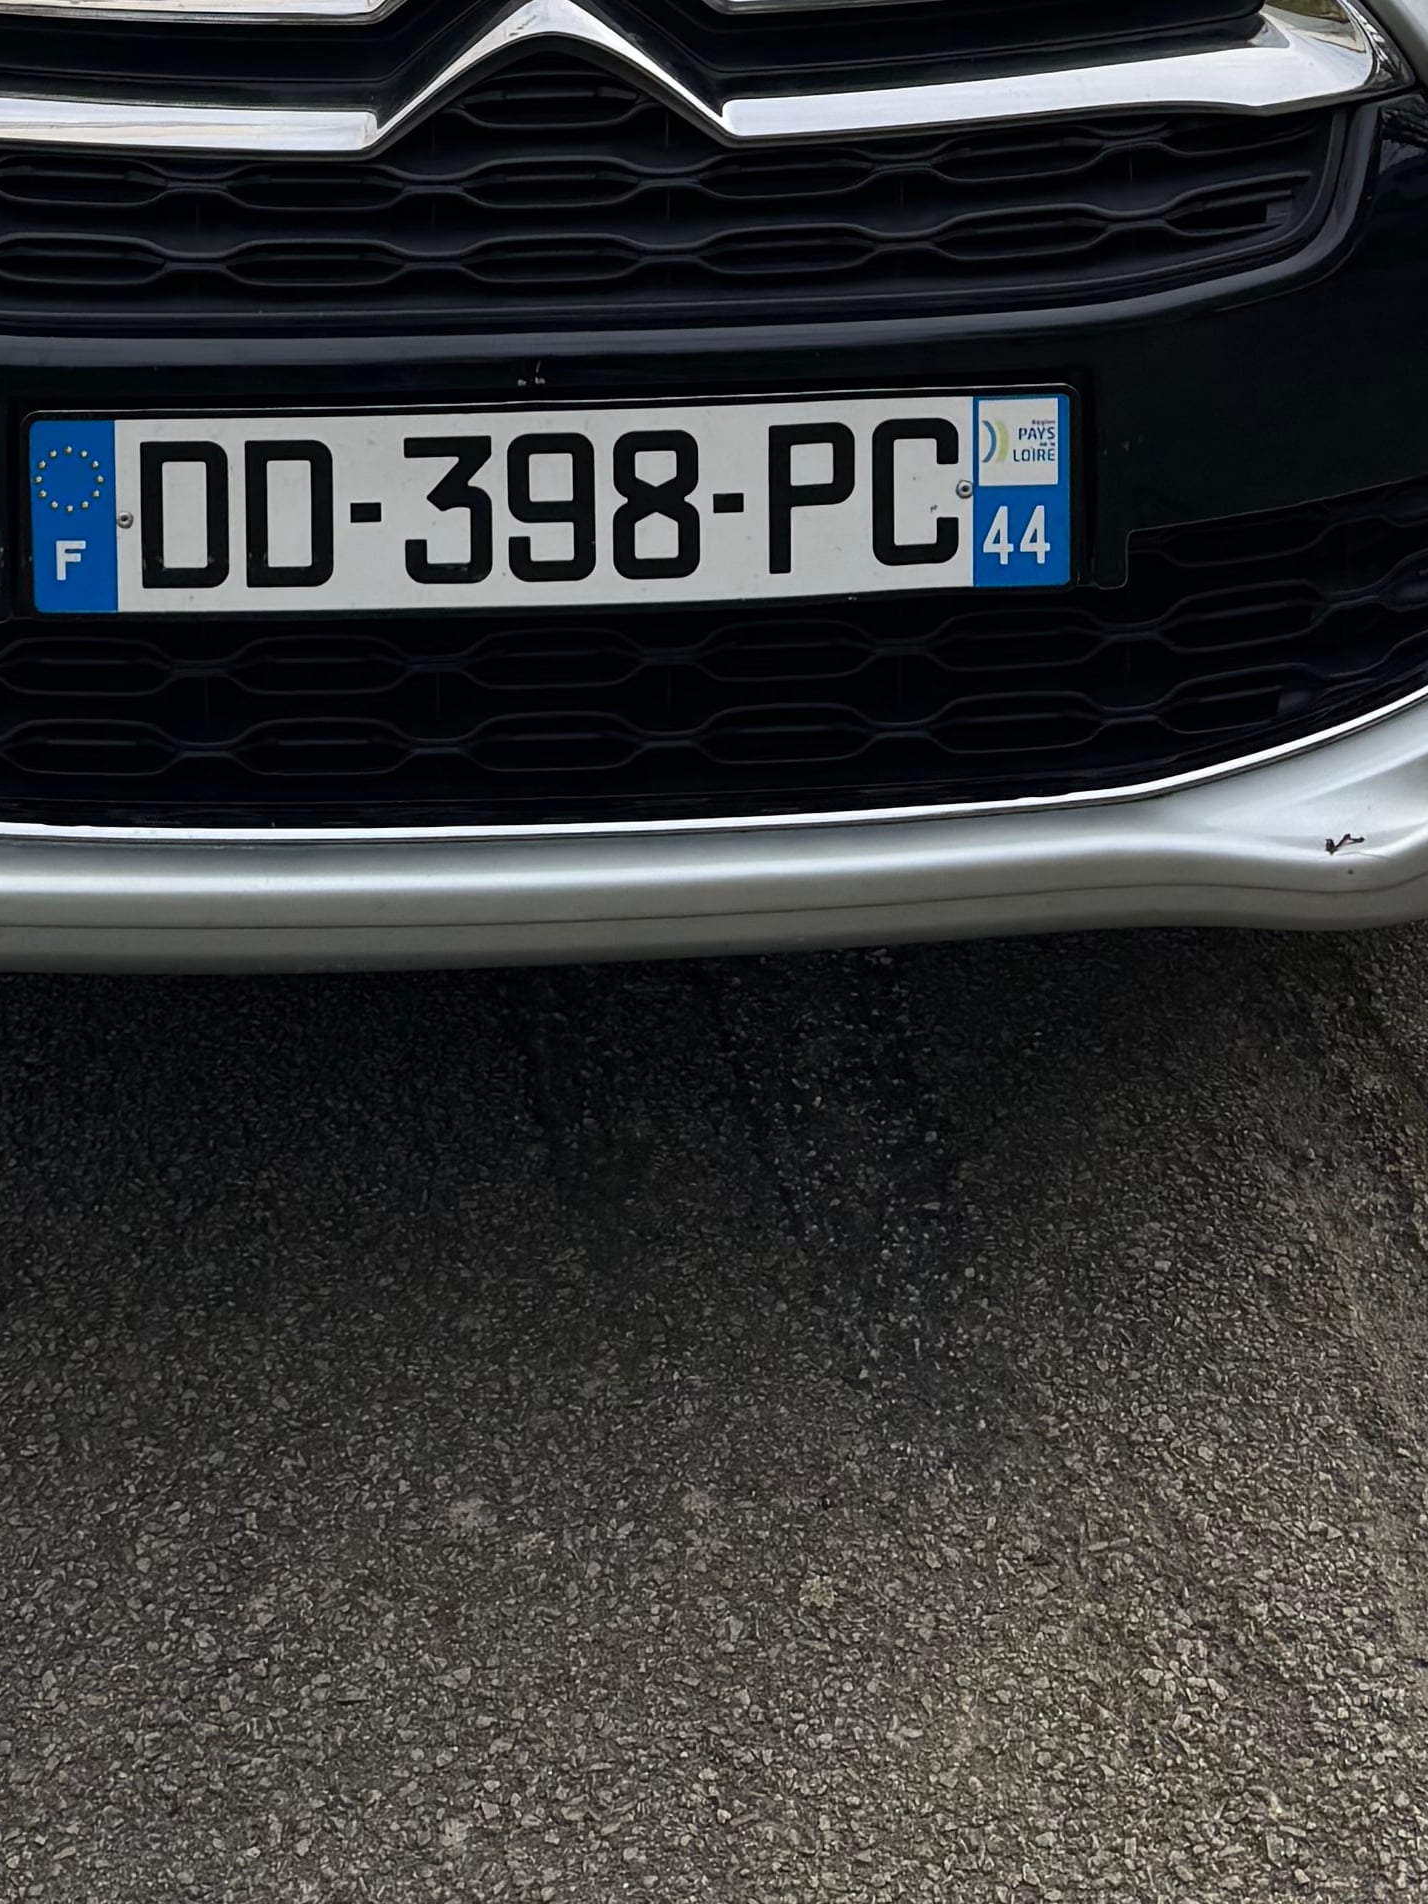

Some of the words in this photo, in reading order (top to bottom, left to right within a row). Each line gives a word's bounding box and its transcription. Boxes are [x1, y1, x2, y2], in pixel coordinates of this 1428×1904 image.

[1018, 426, 1056, 441] PAYS
[1013, 447, 1056, 462] LOIRE
[139, 417, 960, 589] DD-398-PC
[982, 504, 1051, 565] 44
[55, 540, 86, 581] F
